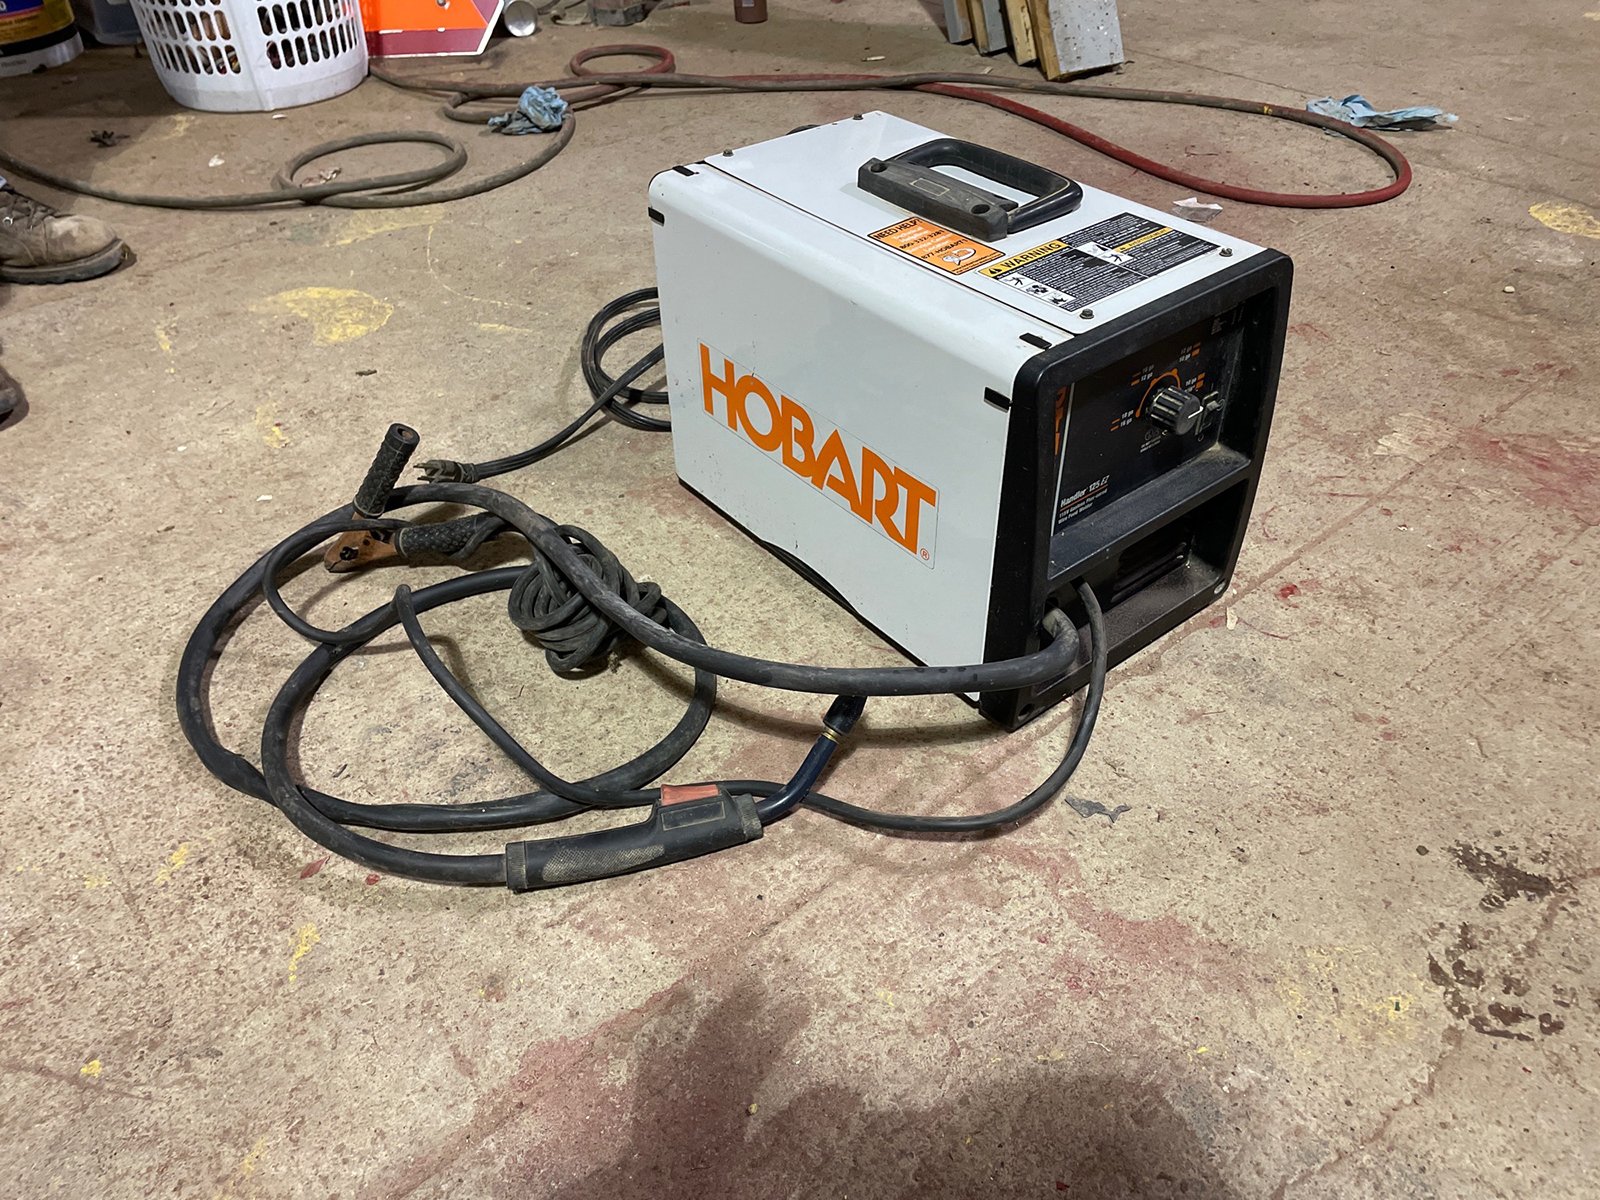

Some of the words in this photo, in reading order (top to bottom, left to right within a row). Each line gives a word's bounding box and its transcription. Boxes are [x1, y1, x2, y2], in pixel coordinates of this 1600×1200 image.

[873, 228, 898, 239] NEED
[1001, 242, 1062, 268] WARNING
[700, 342, 937, 555] HOBART
[1060, 489, 1087, 507] Handler
[1089, 480, 1101, 492] 125
